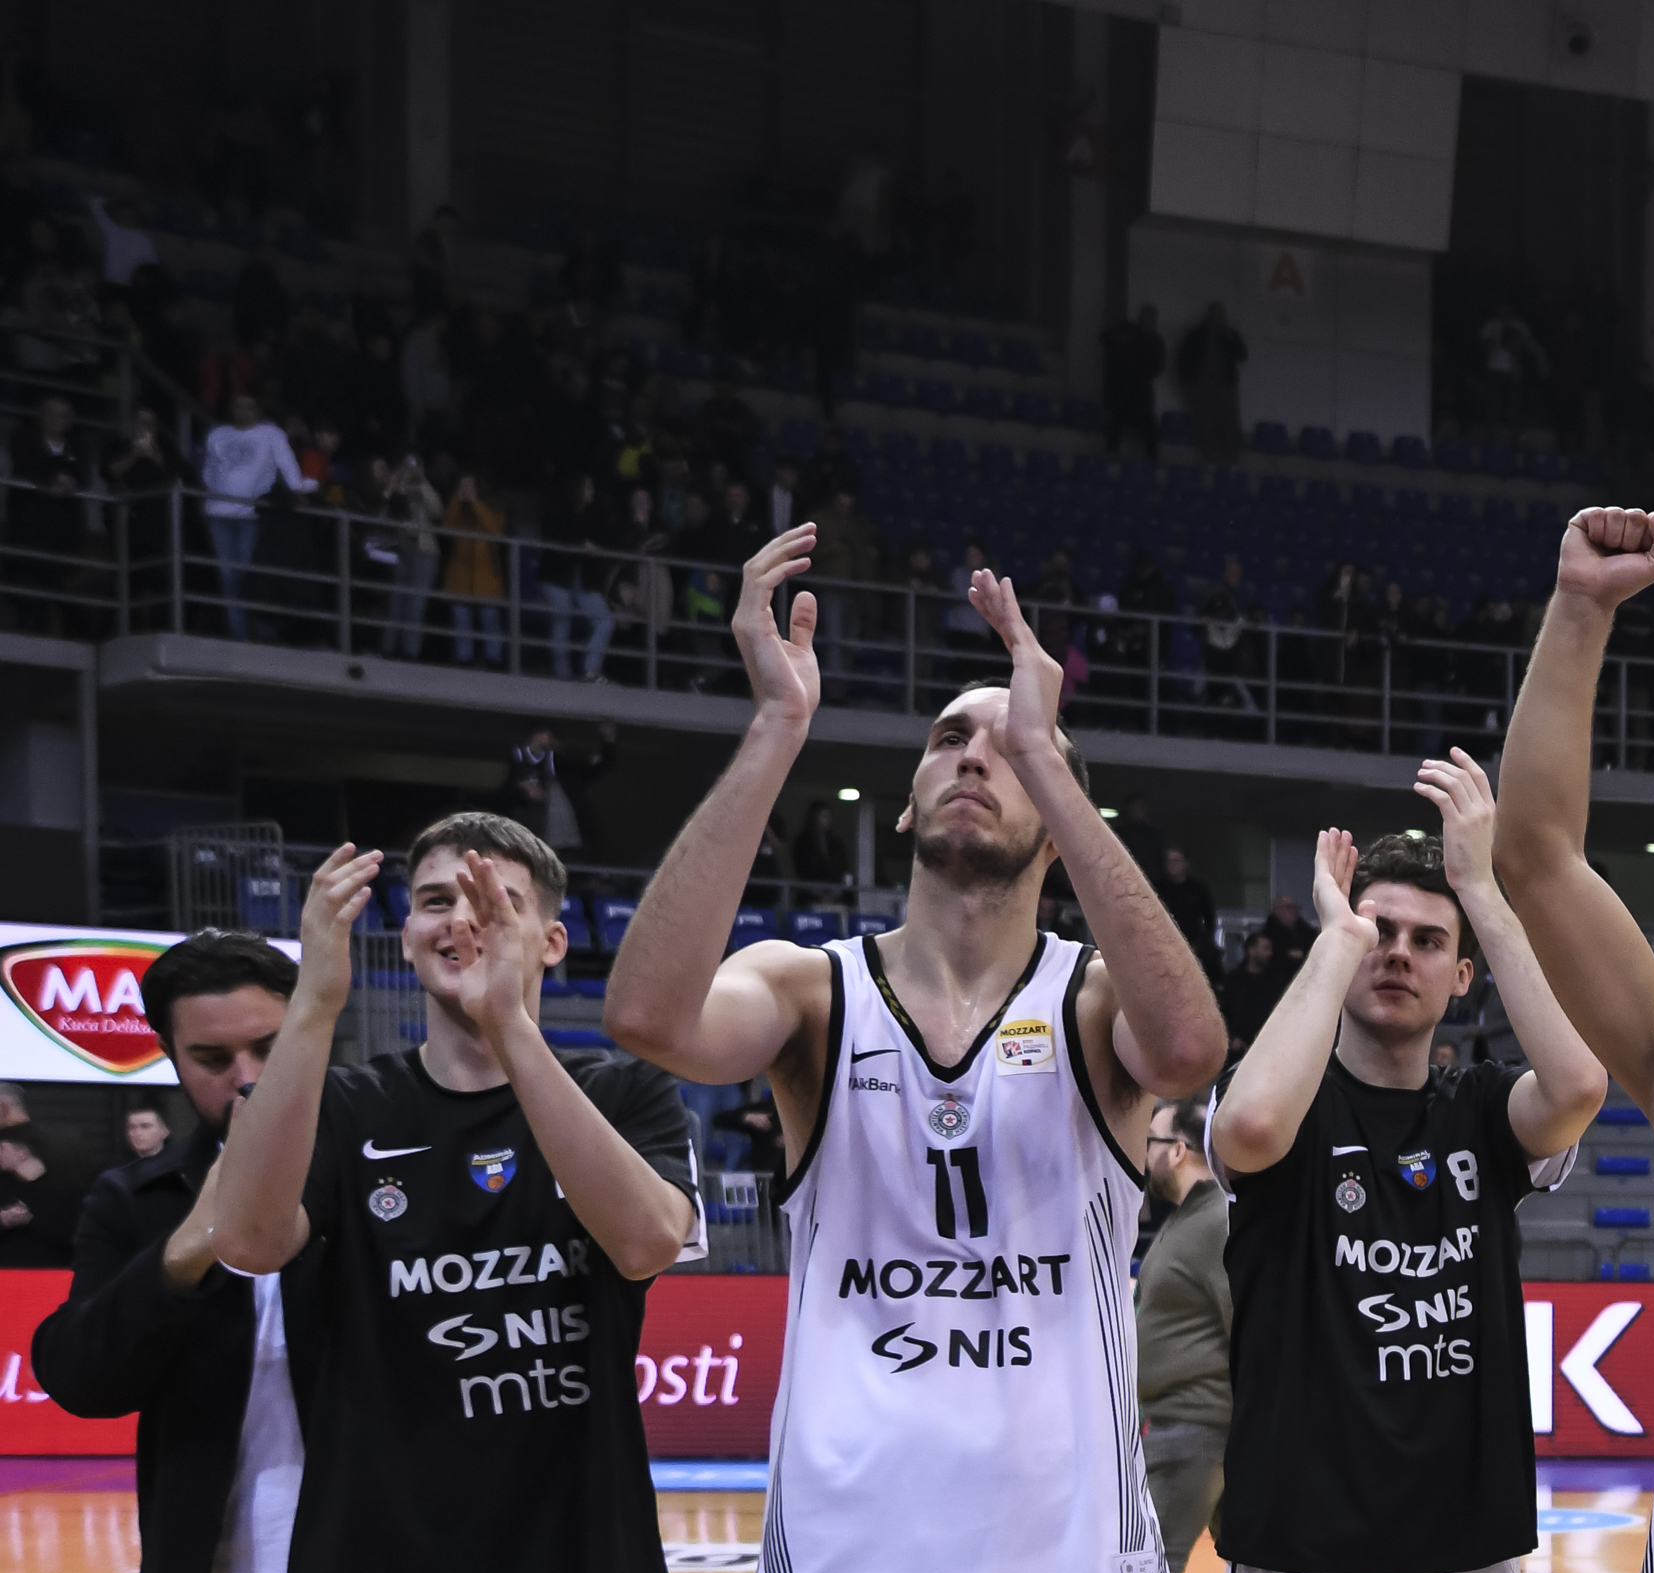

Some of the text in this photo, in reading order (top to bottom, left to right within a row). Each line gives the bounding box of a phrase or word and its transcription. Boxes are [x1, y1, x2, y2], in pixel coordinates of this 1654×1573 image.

[1270, 253, 1304, 294] A
[39, 962, 147, 1014] MA
[102, 1018, 157, 1036] Delika
[1000, 1025, 1047, 1037] MOZZART
[926, 1145, 989, 1240] 11
[1446, 1149, 1480, 1201] 8
[390, 1238, 591, 1298] MOZZAR
[1334, 1225, 1480, 1278] MOZZAR
[838, 1254, 1071, 1300] MOZZART
[504, 1304, 591, 1349] NIS
[1415, 1285, 1474, 1329] NIS
[635, 1333, 743, 1405] osti
[948, 1326, 1033, 1369] NIS
[1378, 1333, 1475, 1382] mts
[1523, 1300, 1645, 1436] K
[459, 1358, 591, 1419] mts
